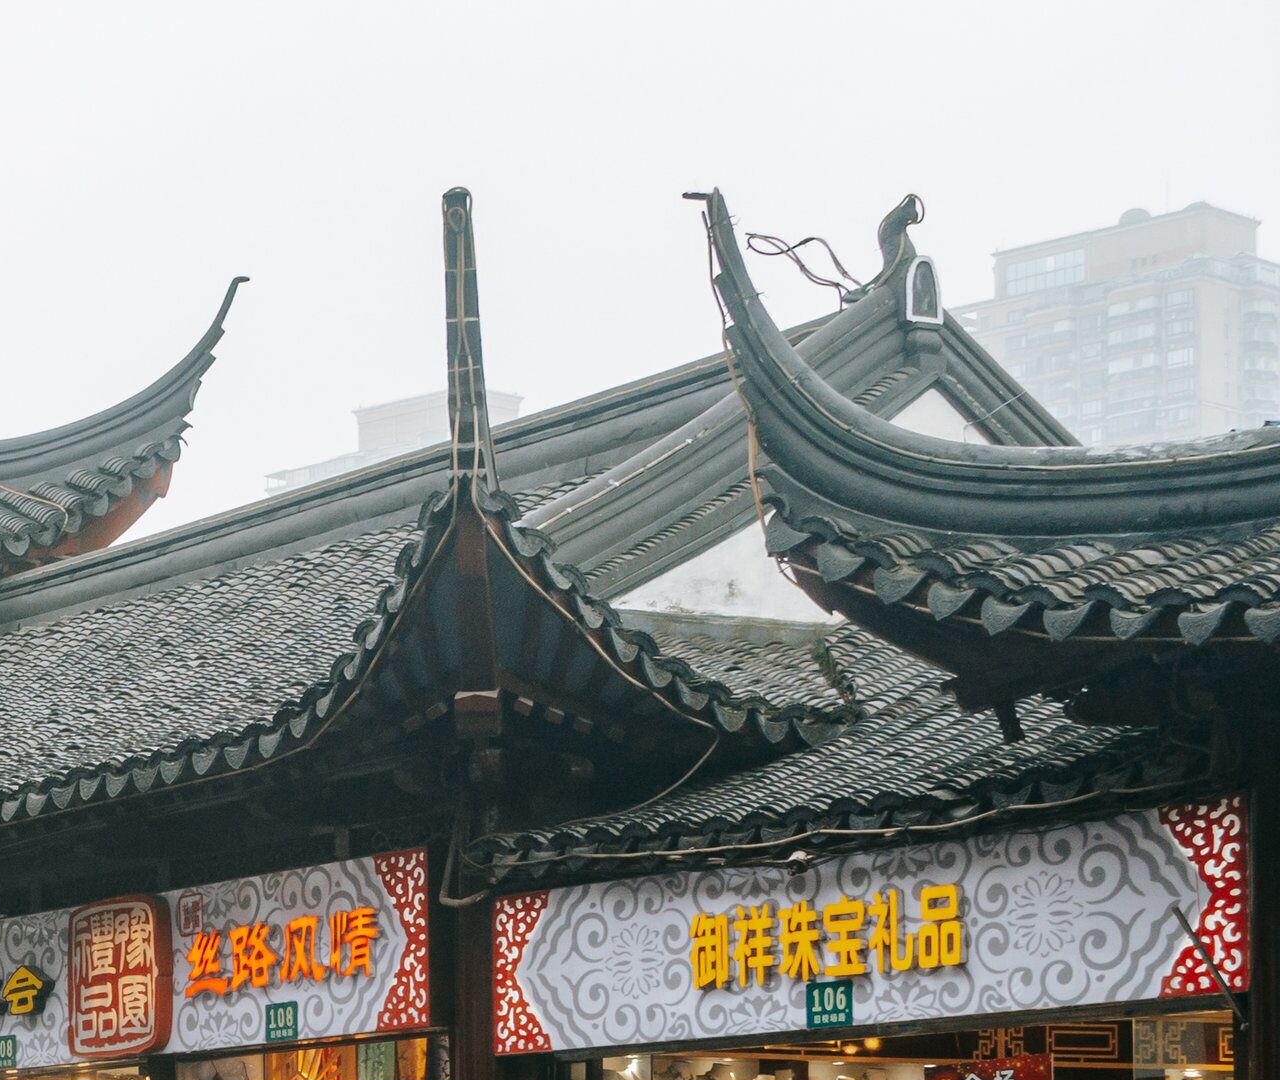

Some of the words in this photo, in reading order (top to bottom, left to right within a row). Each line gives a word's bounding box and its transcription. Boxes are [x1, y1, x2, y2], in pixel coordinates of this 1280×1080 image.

[184, 905, 382, 999] 丝路风情
[689, 883, 964, 992] 御祥珠宝礼品
[269, 1006, 294, 1029] 108
[812, 986, 847, 1012] 106
